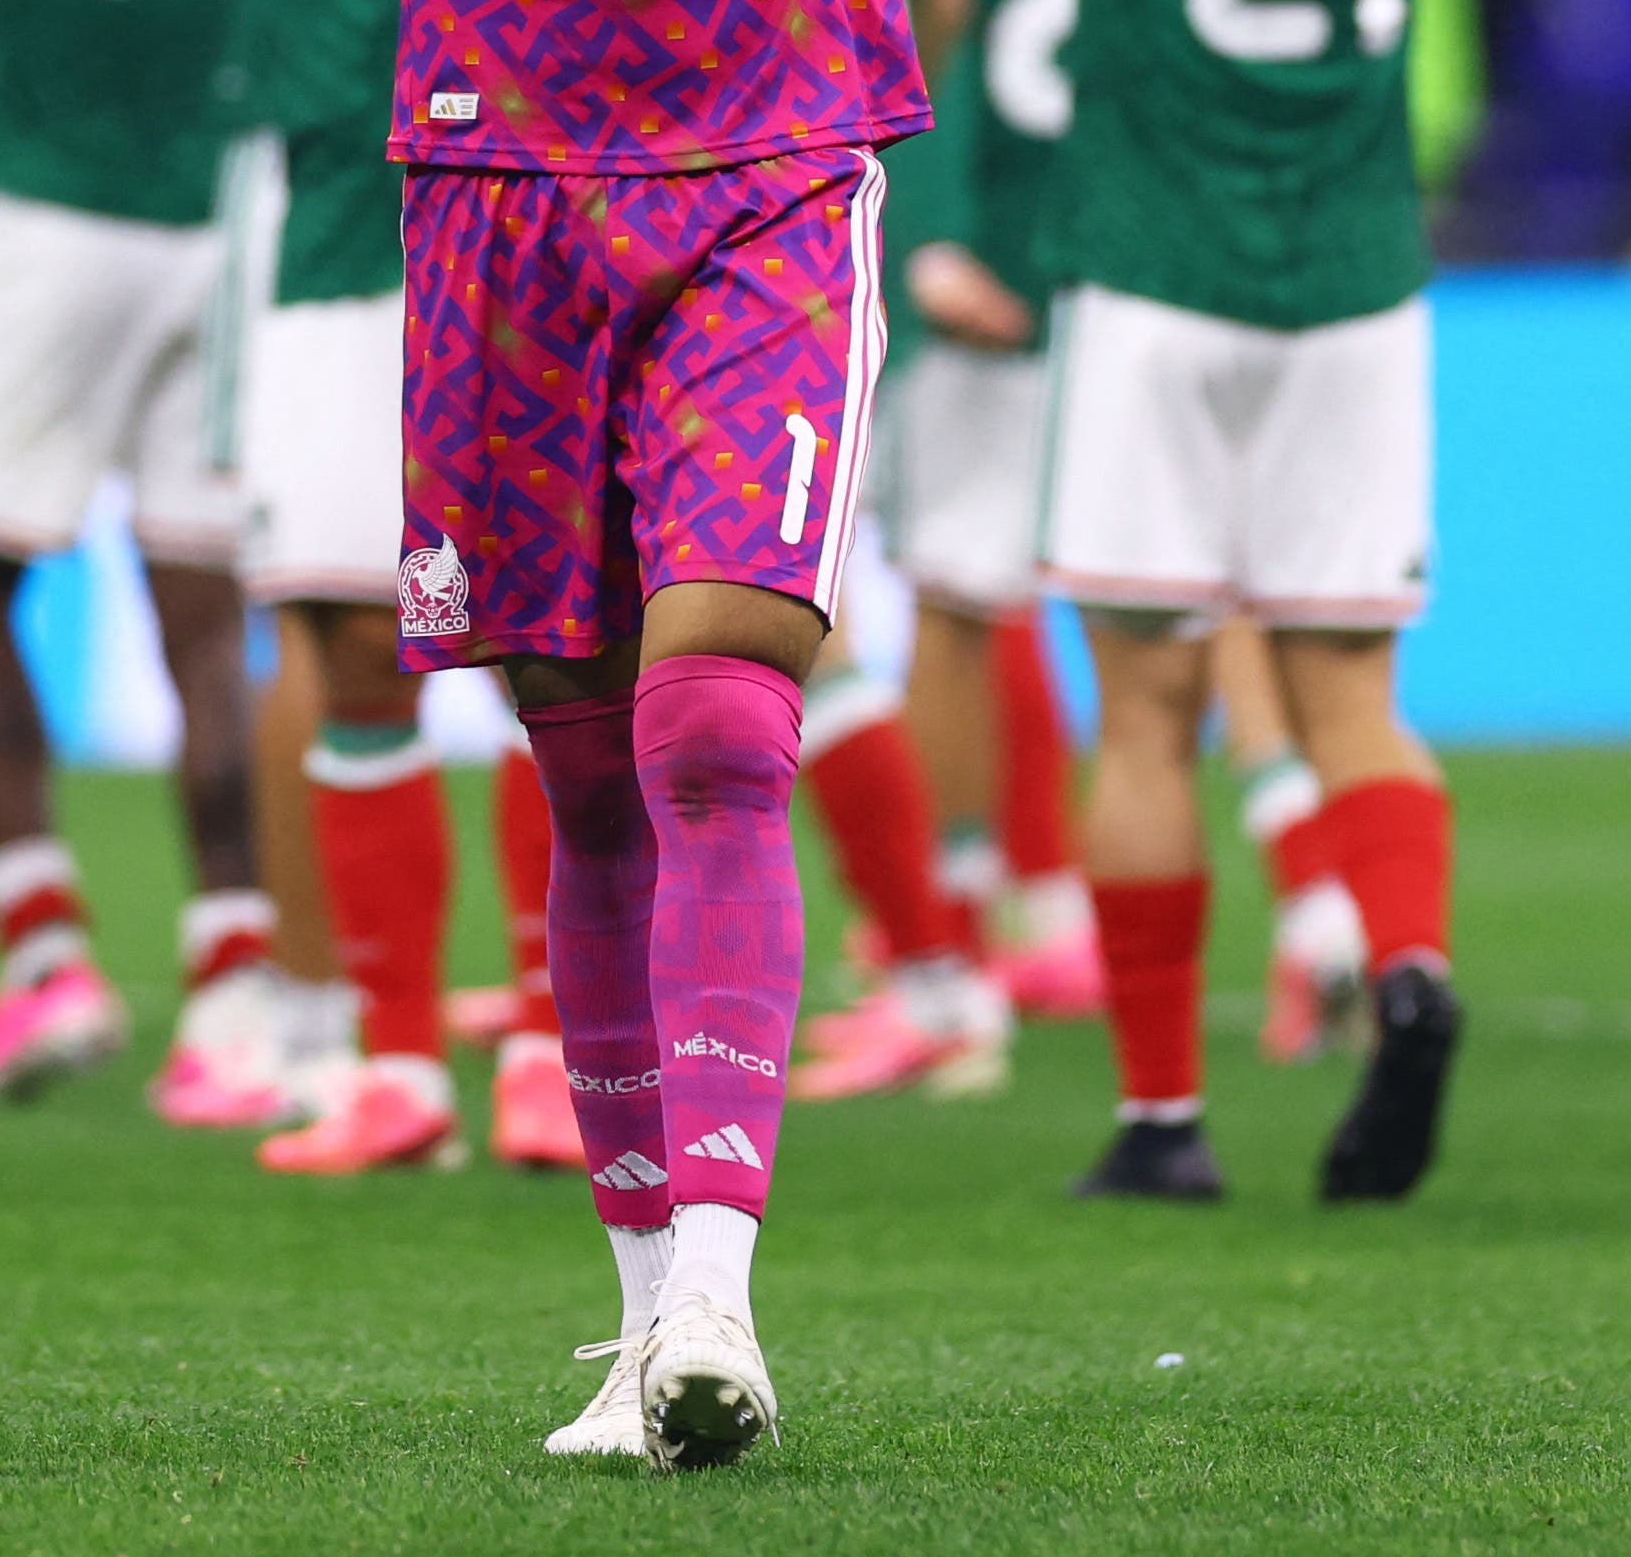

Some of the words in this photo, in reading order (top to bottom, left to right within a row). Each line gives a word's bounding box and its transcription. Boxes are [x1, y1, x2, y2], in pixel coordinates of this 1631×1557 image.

[780, 414, 817, 545] 1
[404, 616, 466, 634] MÉXICO
[673, 1031, 778, 1079] MÉXICO
[568, 1068, 661, 1094] ÉXICO
